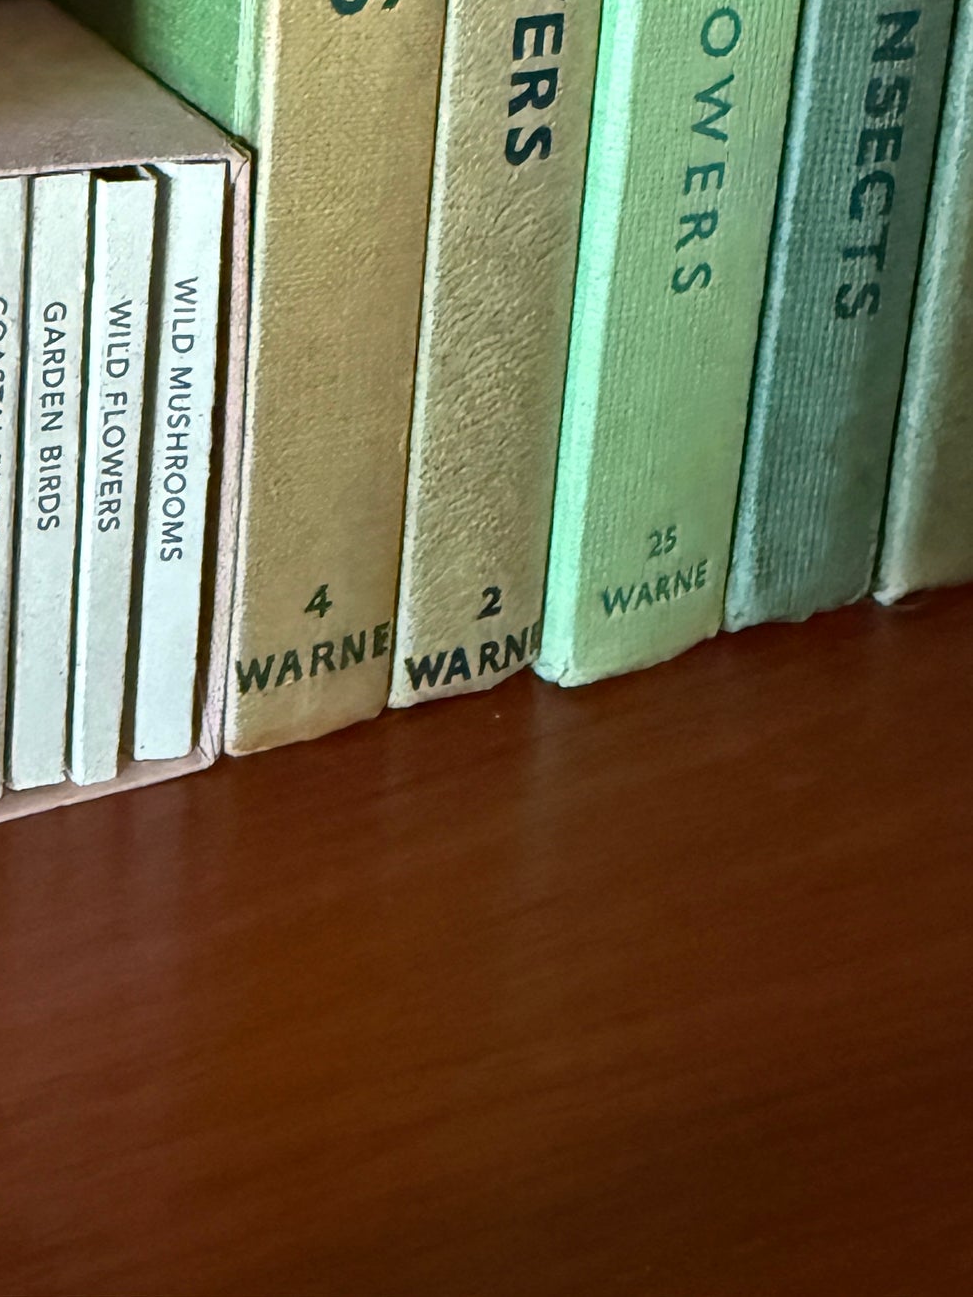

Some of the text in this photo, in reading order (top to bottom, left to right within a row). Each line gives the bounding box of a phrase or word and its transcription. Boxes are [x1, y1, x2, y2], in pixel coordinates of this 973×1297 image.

[37, 301, 67, 531] GARDEN BIRDS
[98, 299, 133, 533] WILD FLOWERS
[159, 276, 200, 561] WILD MUSHROOMS
[648, 524, 678, 557] 25
[304, 582, 333, 619] 4
[477, 586, 503, 619] 2
[601, 559, 709, 619] WARNE
[236, 620, 392, 695] WARNE
